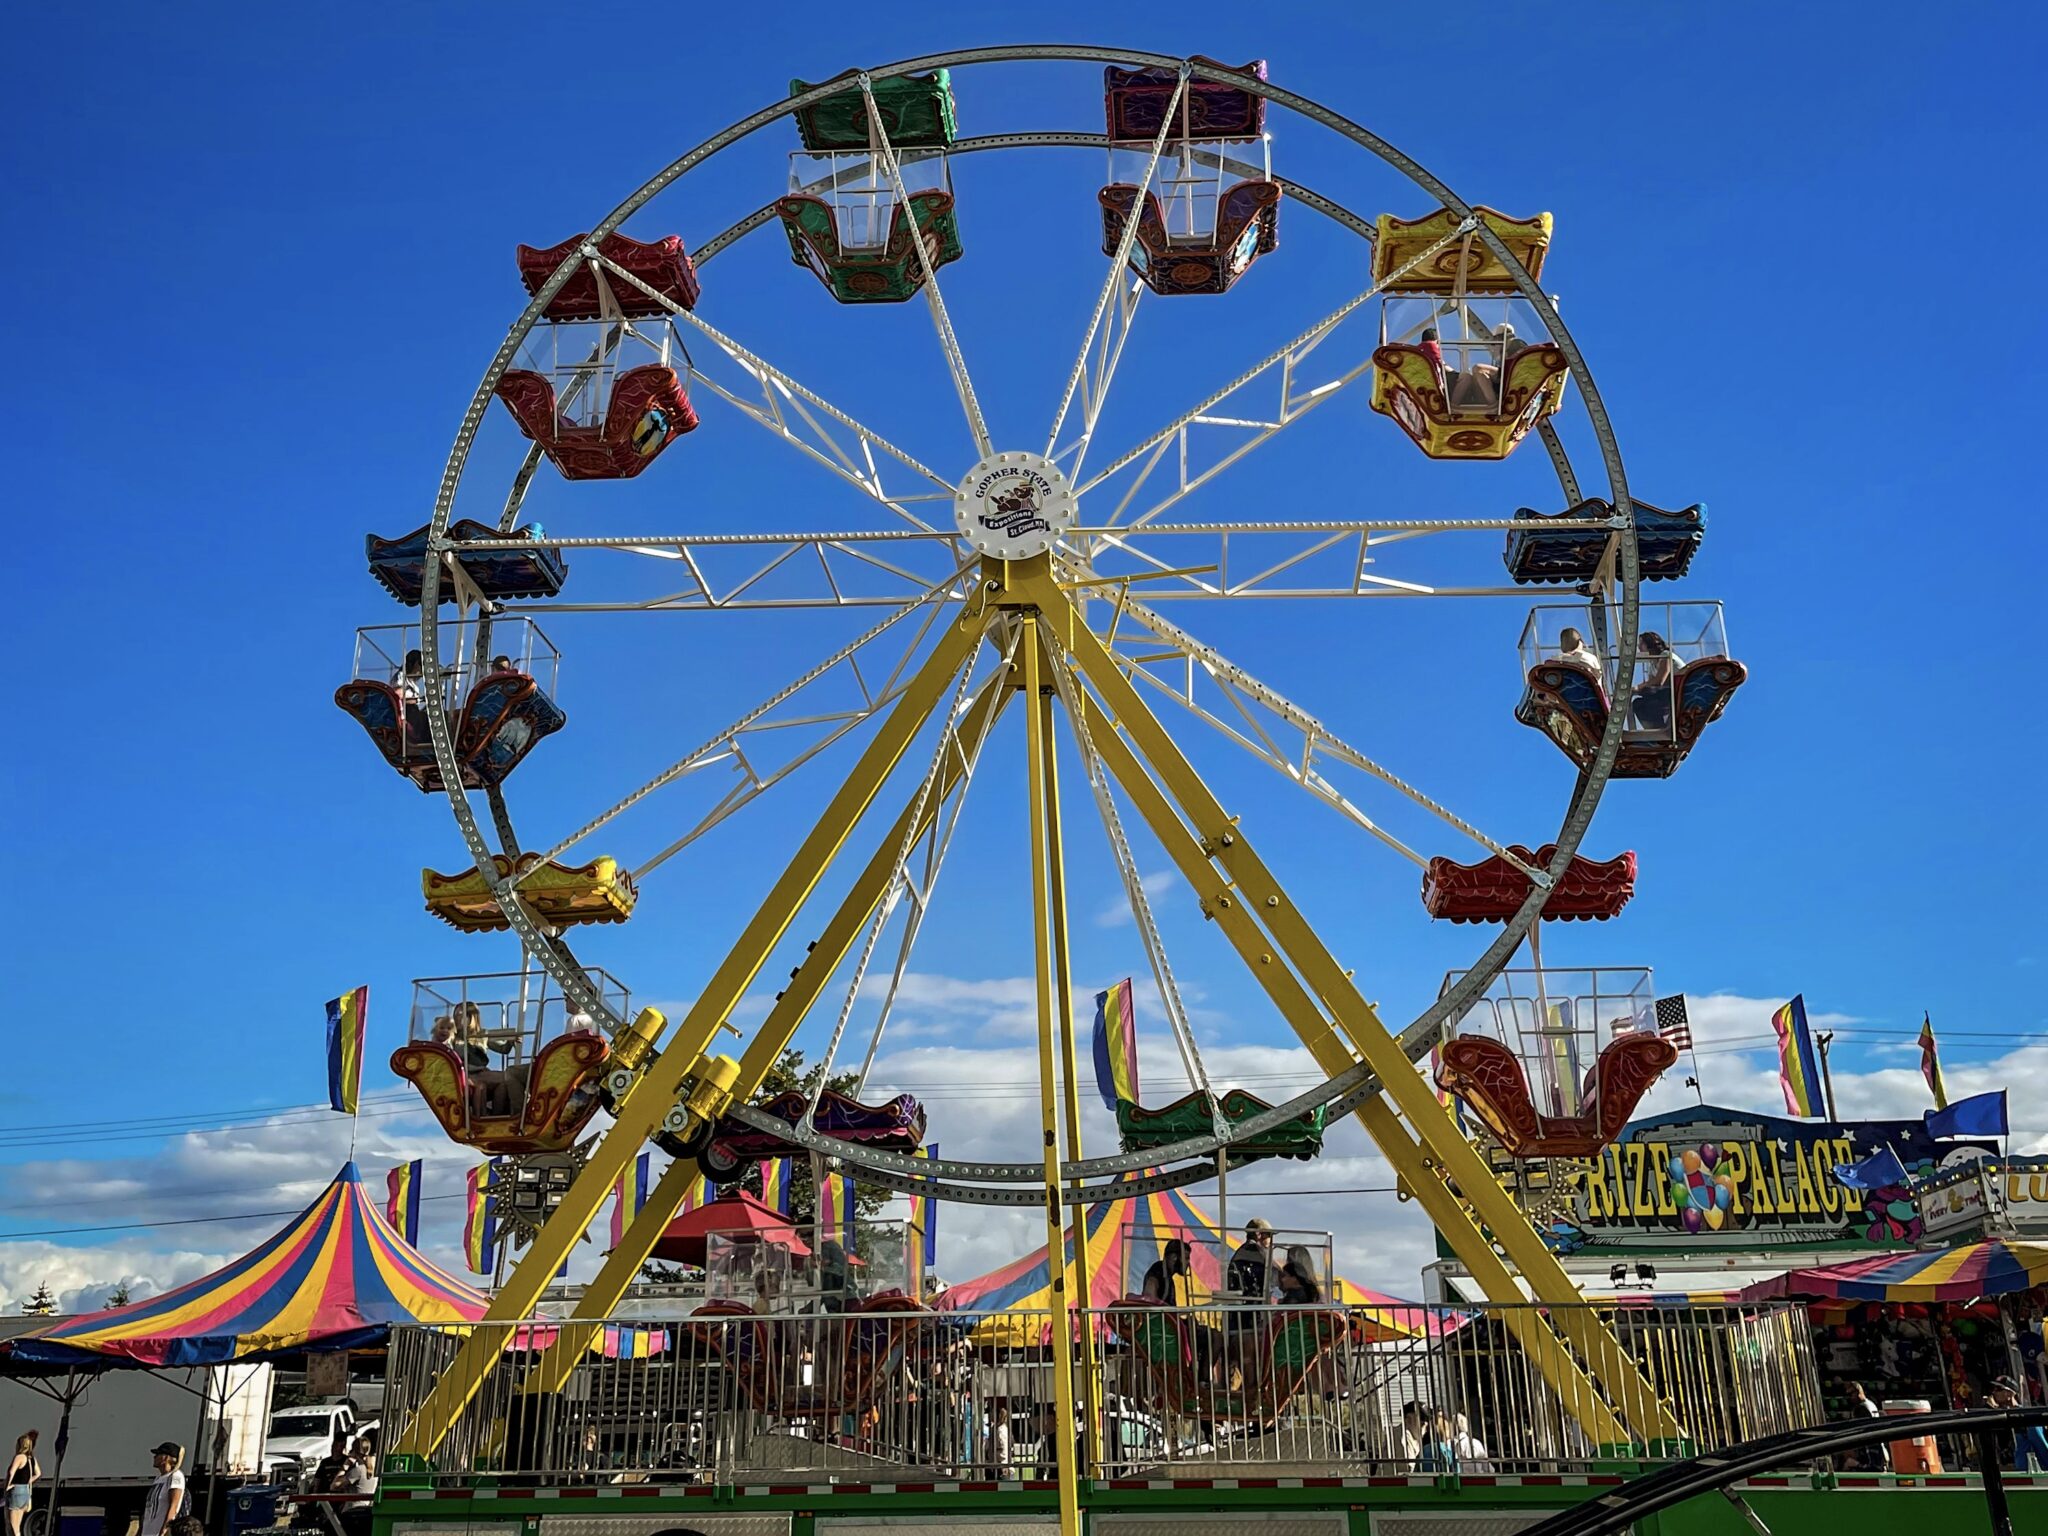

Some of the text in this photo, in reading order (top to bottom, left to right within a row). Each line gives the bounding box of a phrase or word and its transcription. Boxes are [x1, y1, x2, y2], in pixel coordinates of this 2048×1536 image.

[975, 467, 1052, 498] GOPHER STATE
[989, 510, 1032, 528] Expositions
[1722, 1137, 1862, 1215] PALACE
